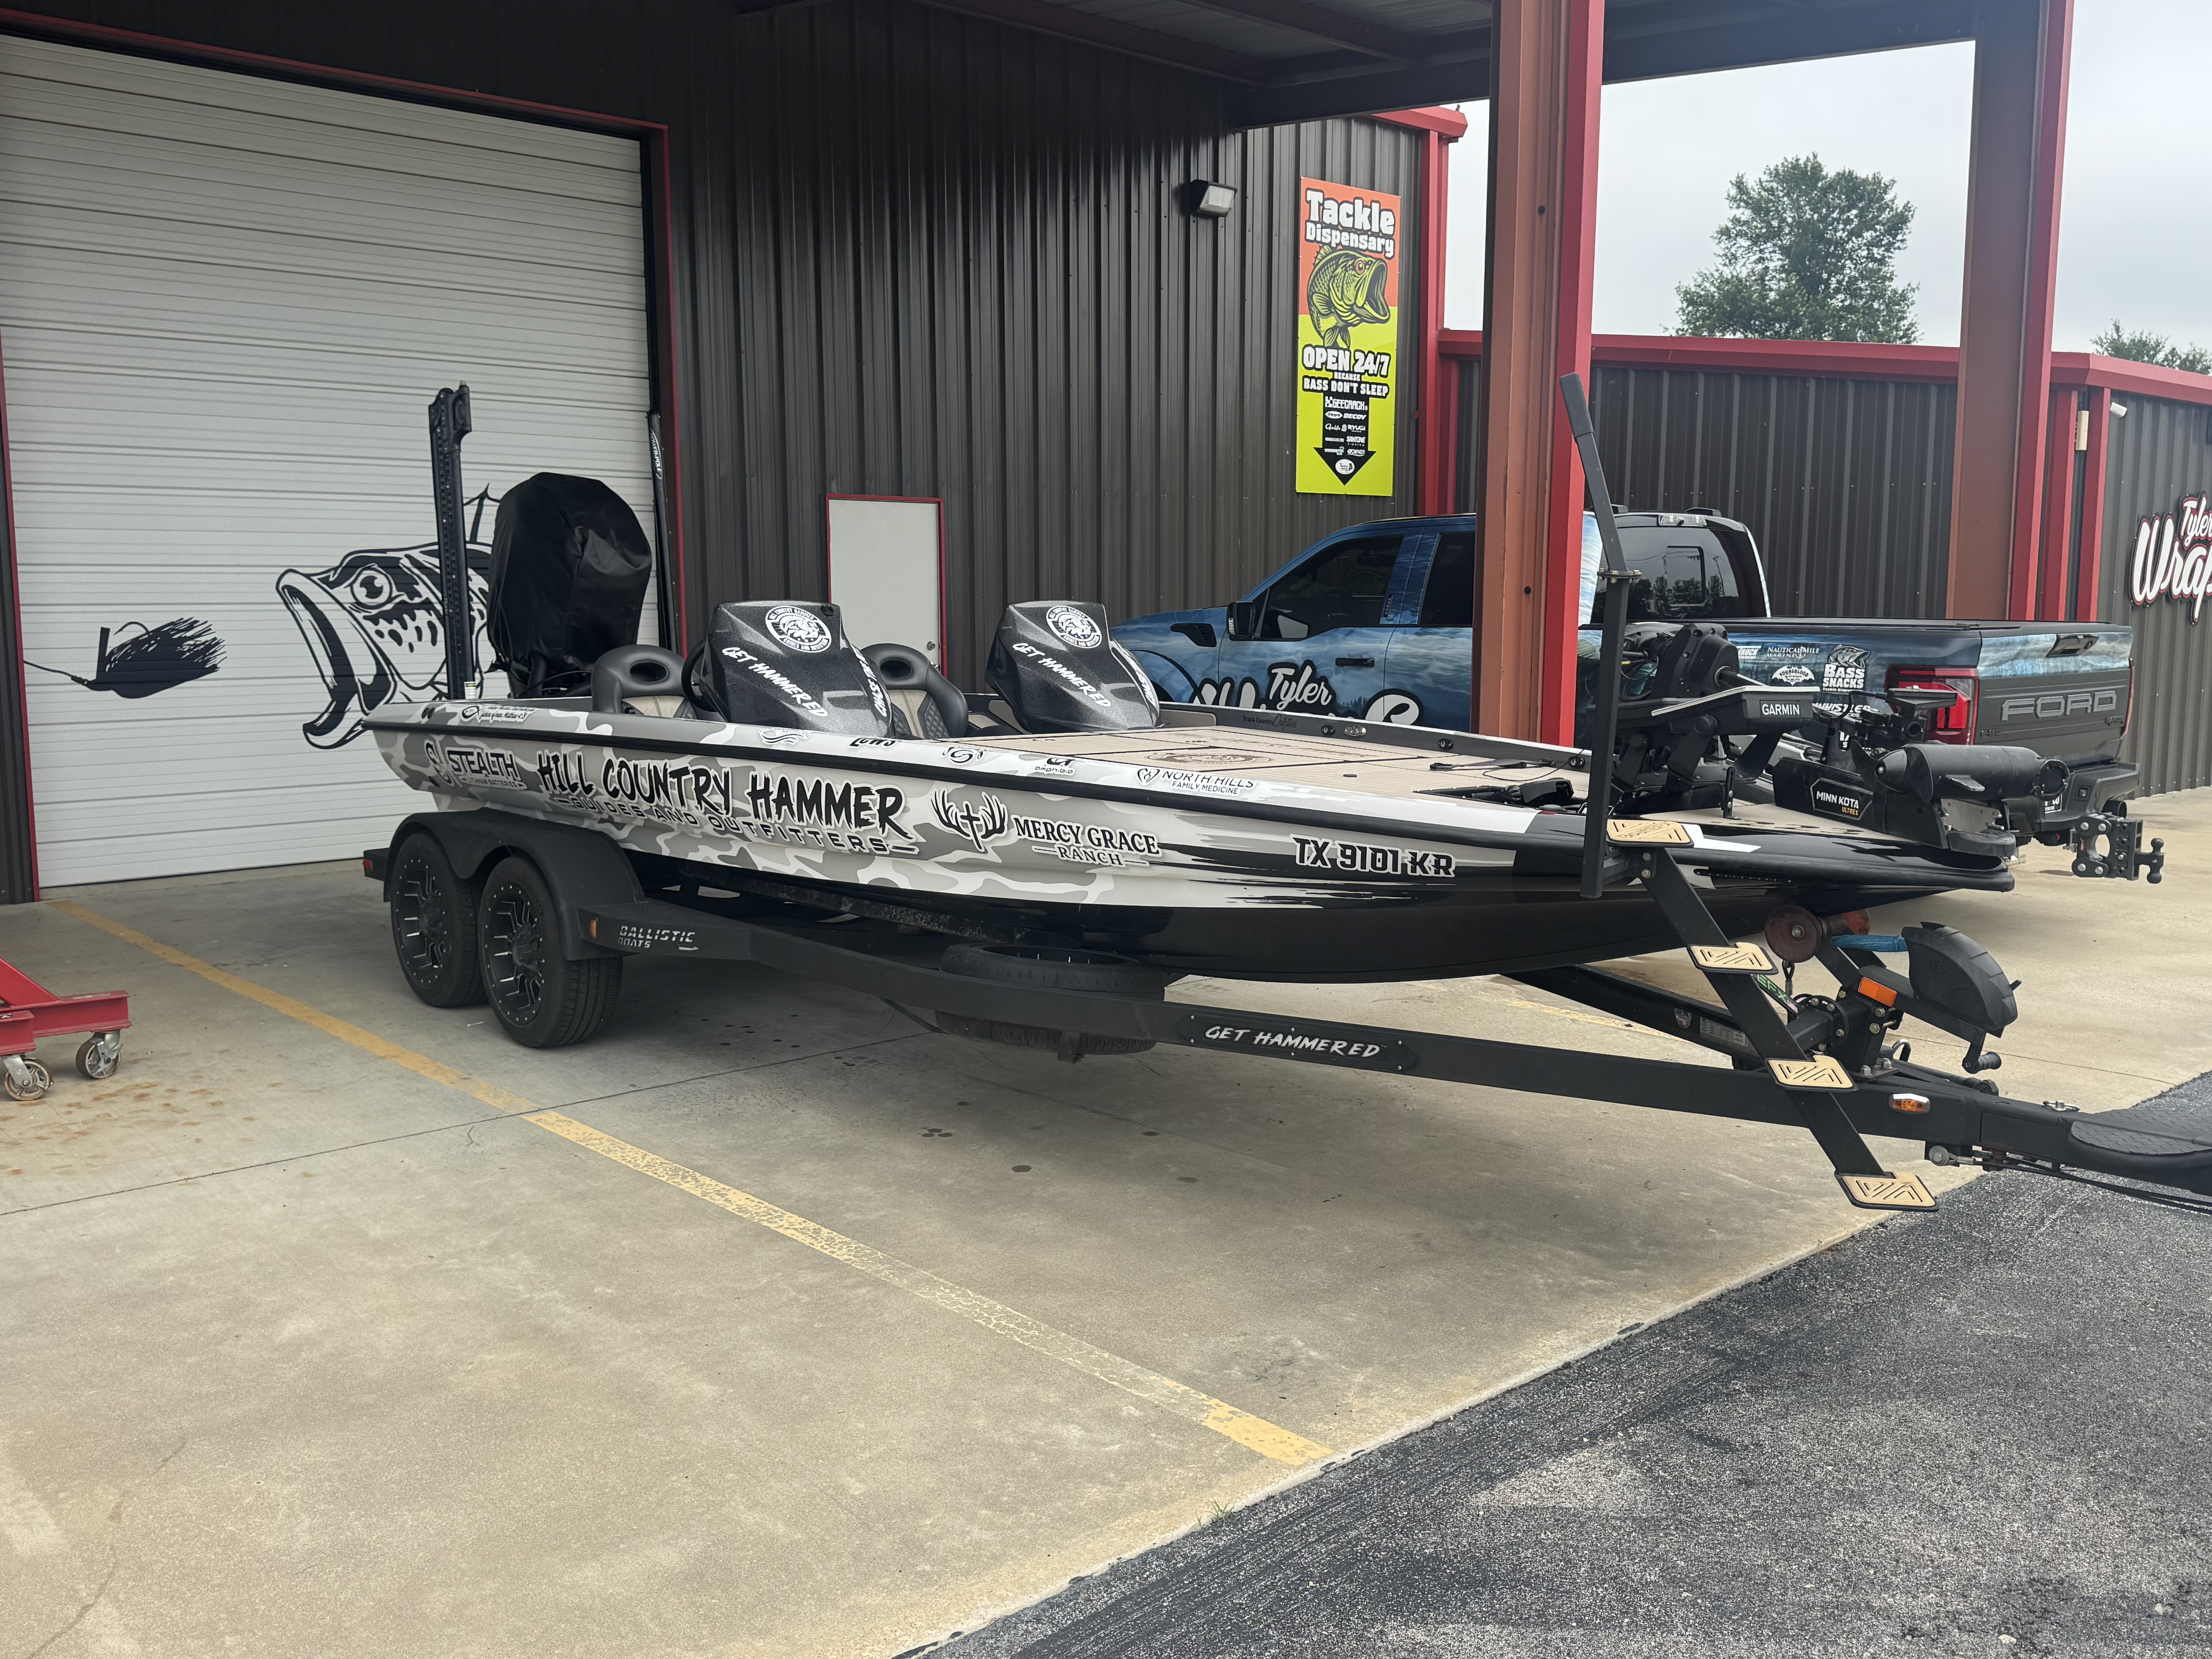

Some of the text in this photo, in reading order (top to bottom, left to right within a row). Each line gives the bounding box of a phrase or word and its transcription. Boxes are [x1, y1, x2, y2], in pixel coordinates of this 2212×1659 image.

[1307, 190, 1395, 235] Tackle
[1306, 222, 1394, 258] Dispensary
[1304, 346, 1389, 376] OPEN 24/7
[1304, 378, 1388, 396] BASS DON'T SLEEP
[1334, 372, 1360, 381] BECAUSE
[721, 647, 828, 717] GET HAMMERED
[1012, 642, 1112, 707] GET HAMMERED
[1779, 669, 1808, 677] YOUNGBLOOD
[1822, 678, 1864, 689] SNACKS
[1824, 664, 1865, 678] BASS
[1271, 665, 1332, 710] Tyler
[1762, 704, 1800, 715] GARMIN
[2000, 690, 2117, 722] FORD
[447, 750, 519, 779] STEALTH
[1035, 766, 1073, 774] amphibia
[1162, 771, 1254, 788] NORTH HILLS
[1171, 781, 1239, 794] FAMILY MEDICINE
[537, 750, 915, 840] HILL COUNTRY HAMMER
[1816, 791, 1859, 809] MINN KOTA
[572, 798, 888, 852] GUIDES AND OUTFITTERS
[1842, 806, 1859, 816] ULTREX
[1013, 817, 1160, 854] MERCY GRACE
[1057, 845, 1123, 866] RANCH
[1293, 837, 1454, 876] TX 9101 KR
[620, 926, 696, 942] BALLISTIC
[1757, 974, 1787, 1004] EFX
[1205, 1025, 1380, 1058] GET HAMMERED
